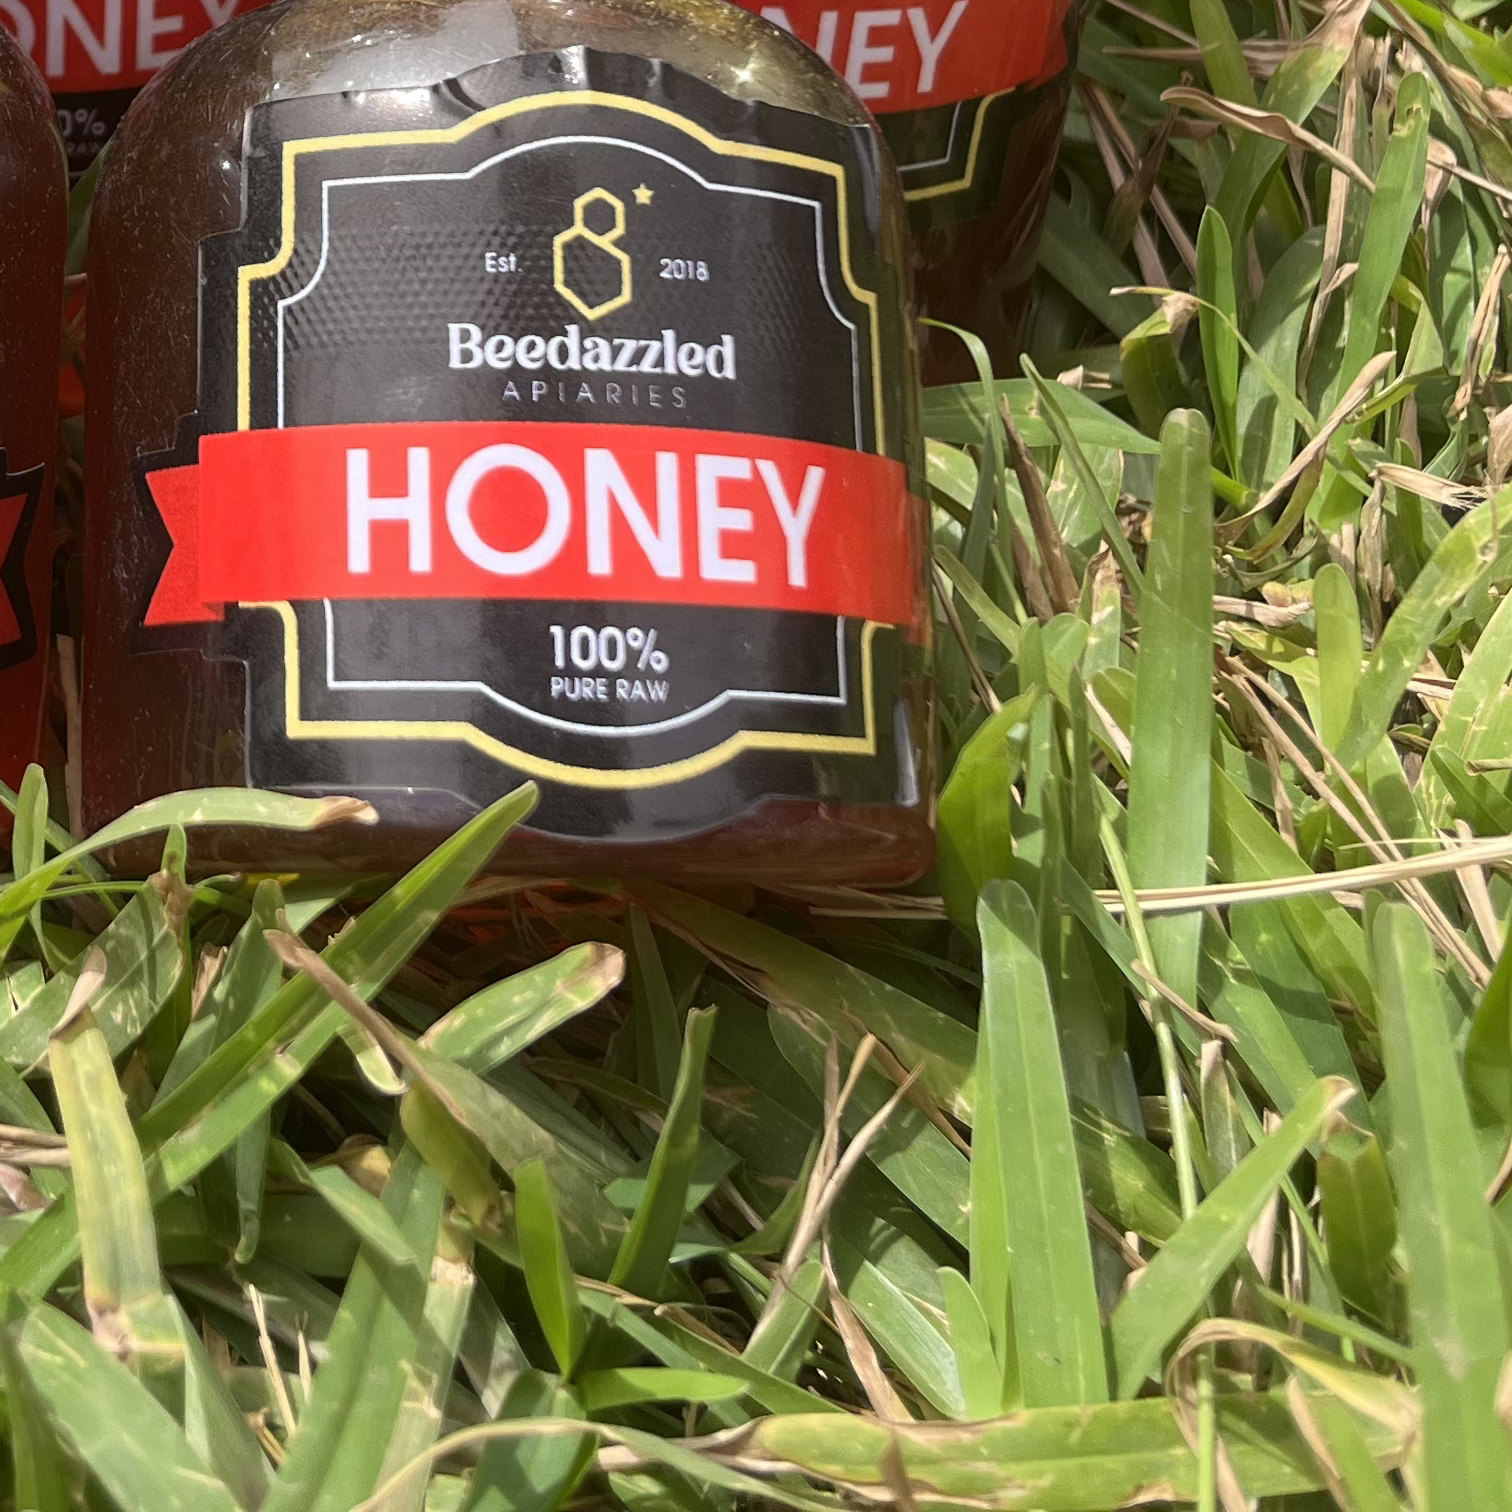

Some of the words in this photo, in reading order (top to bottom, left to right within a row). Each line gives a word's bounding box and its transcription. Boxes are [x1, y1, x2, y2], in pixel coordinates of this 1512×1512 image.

[484, 251, 522, 275] Est.
[659, 257, 710, 283] 2018
[447, 321, 737, 381] Beedazzled
[501, 379, 690, 409] APIARIES
[345, 443, 827, 589] HONEY
[548, 624, 671, 675] 100%
[550, 676, 607, 702] PURE
[615, 678, 671, 705] RAW
